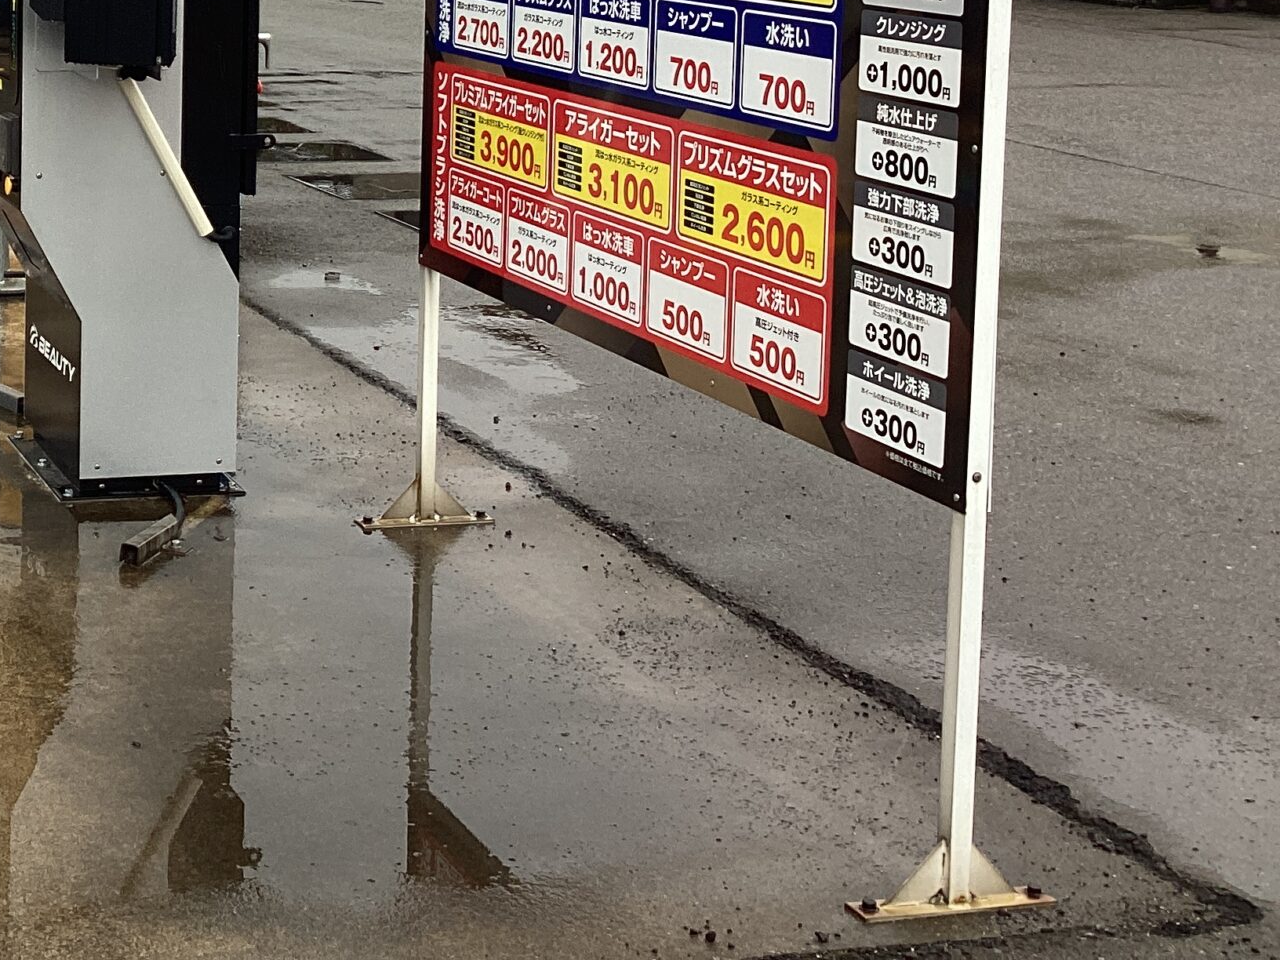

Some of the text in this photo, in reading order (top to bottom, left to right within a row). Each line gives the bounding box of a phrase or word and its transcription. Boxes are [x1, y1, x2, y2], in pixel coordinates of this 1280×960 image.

[457, 15, 504, 49] 2,700円
[667, 7, 724, 32] シャンプー
[765, 21, 810, 48] 水洗い
[876, 16, 946, 42] クレンジング
[517, 27, 569, 63] 2,200円
[585, 41, 643, 79] 1,200円
[670, 56, 719, 95] 700円
[759, 73, 815, 116] 700円
[454, 81, 546, 125] プレミアムアライガーセット
[876, 103, 938, 131] 純水仕上げ
[565, 109, 661, 156] アライガーセット
[434, 72, 448, 241] ソフトブラシ洗浄
[480, 130, 541, 180] 3,900円
[683, 141, 822, 201] プリズムグラスセット
[451, 174, 502, 208] アライガーコート
[588, 162, 663, 219] 3,100円
[741, 191, 798, 216] ガラス系コーティング
[867, 187, 939, 223] 強力下部洗浄
[511, 196, 566, 232] プリズムグラス
[452, 216, 499, 258] 2,500円
[582, 221, 634, 257] はっ水洗車
[721, 203, 815, 270] 2,600円
[511, 239, 563, 285] 2,000円
[659, 249, 716, 282] シャンプー
[579, 266, 636, 315] 1,000円
[756, 283, 800, 317] 水洗い
[662, 299, 711, 346] 500円
[755, 316, 799, 343] 高圧ジェット付き
[38, 335, 76, 382] BEAUTY
[749, 334, 805, 386] 500円
[862, 360, 931, 401] ホイール洗浄
